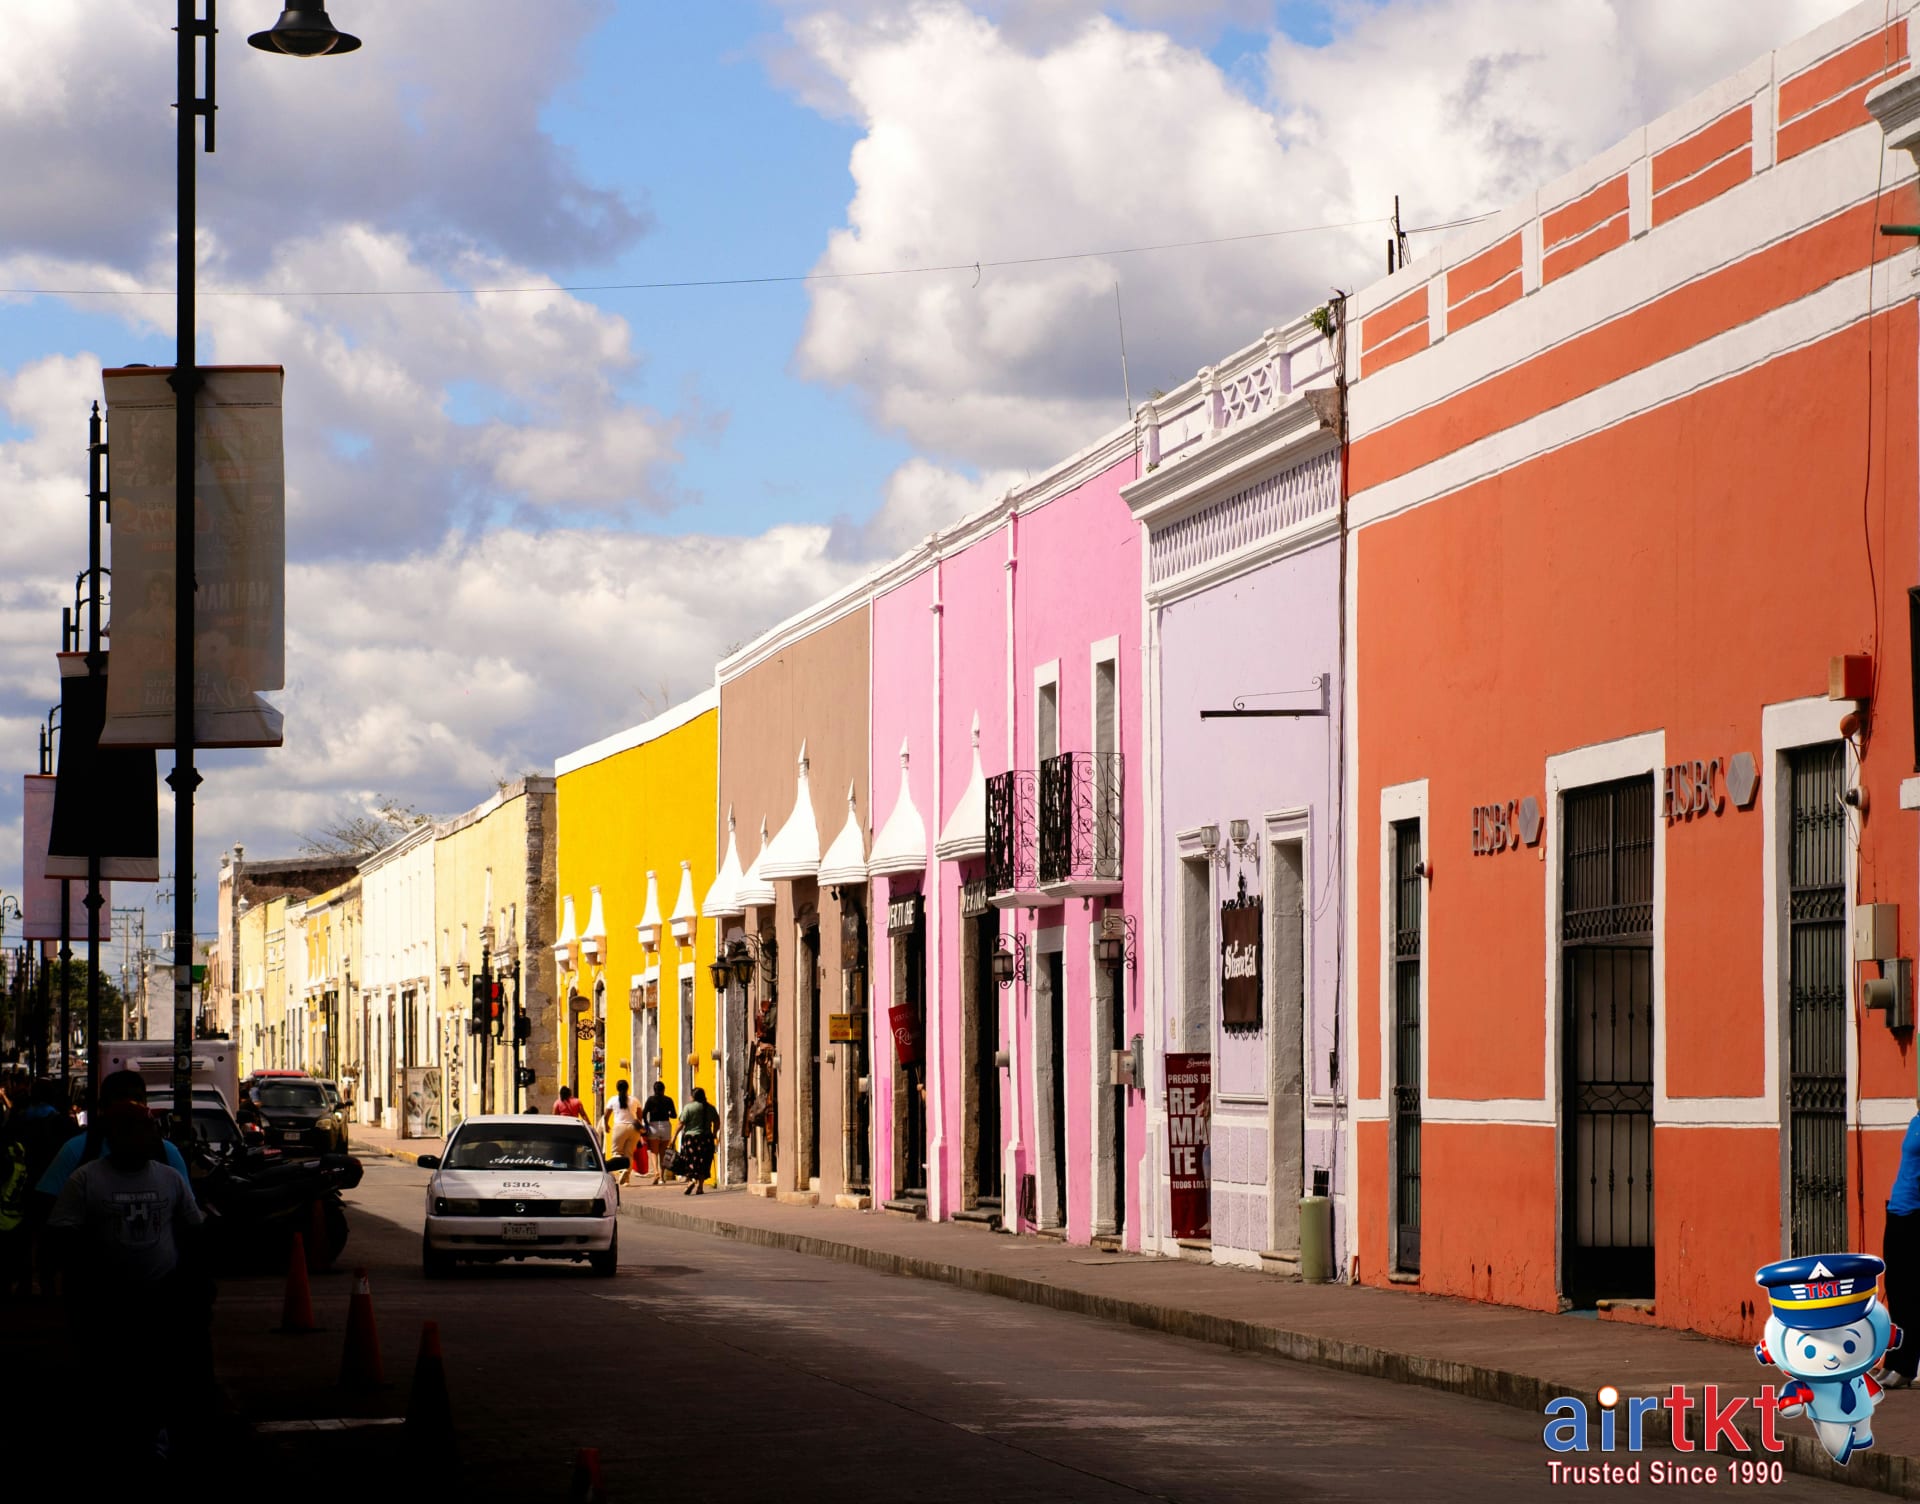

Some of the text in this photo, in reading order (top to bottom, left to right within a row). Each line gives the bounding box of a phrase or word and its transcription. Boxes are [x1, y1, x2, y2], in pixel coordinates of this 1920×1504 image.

[1661, 758, 1724, 818] HSBC
[1471, 799, 1519, 855] HSBC
[1167, 1073, 1211, 1084] PRECIOS DE
[1169, 1087, 1196, 1115] RE
[1171, 1117, 1210, 1145] MA
[1171, 1147, 1197, 1175] TE
[1172, 1180, 1192, 1190] TODOS
